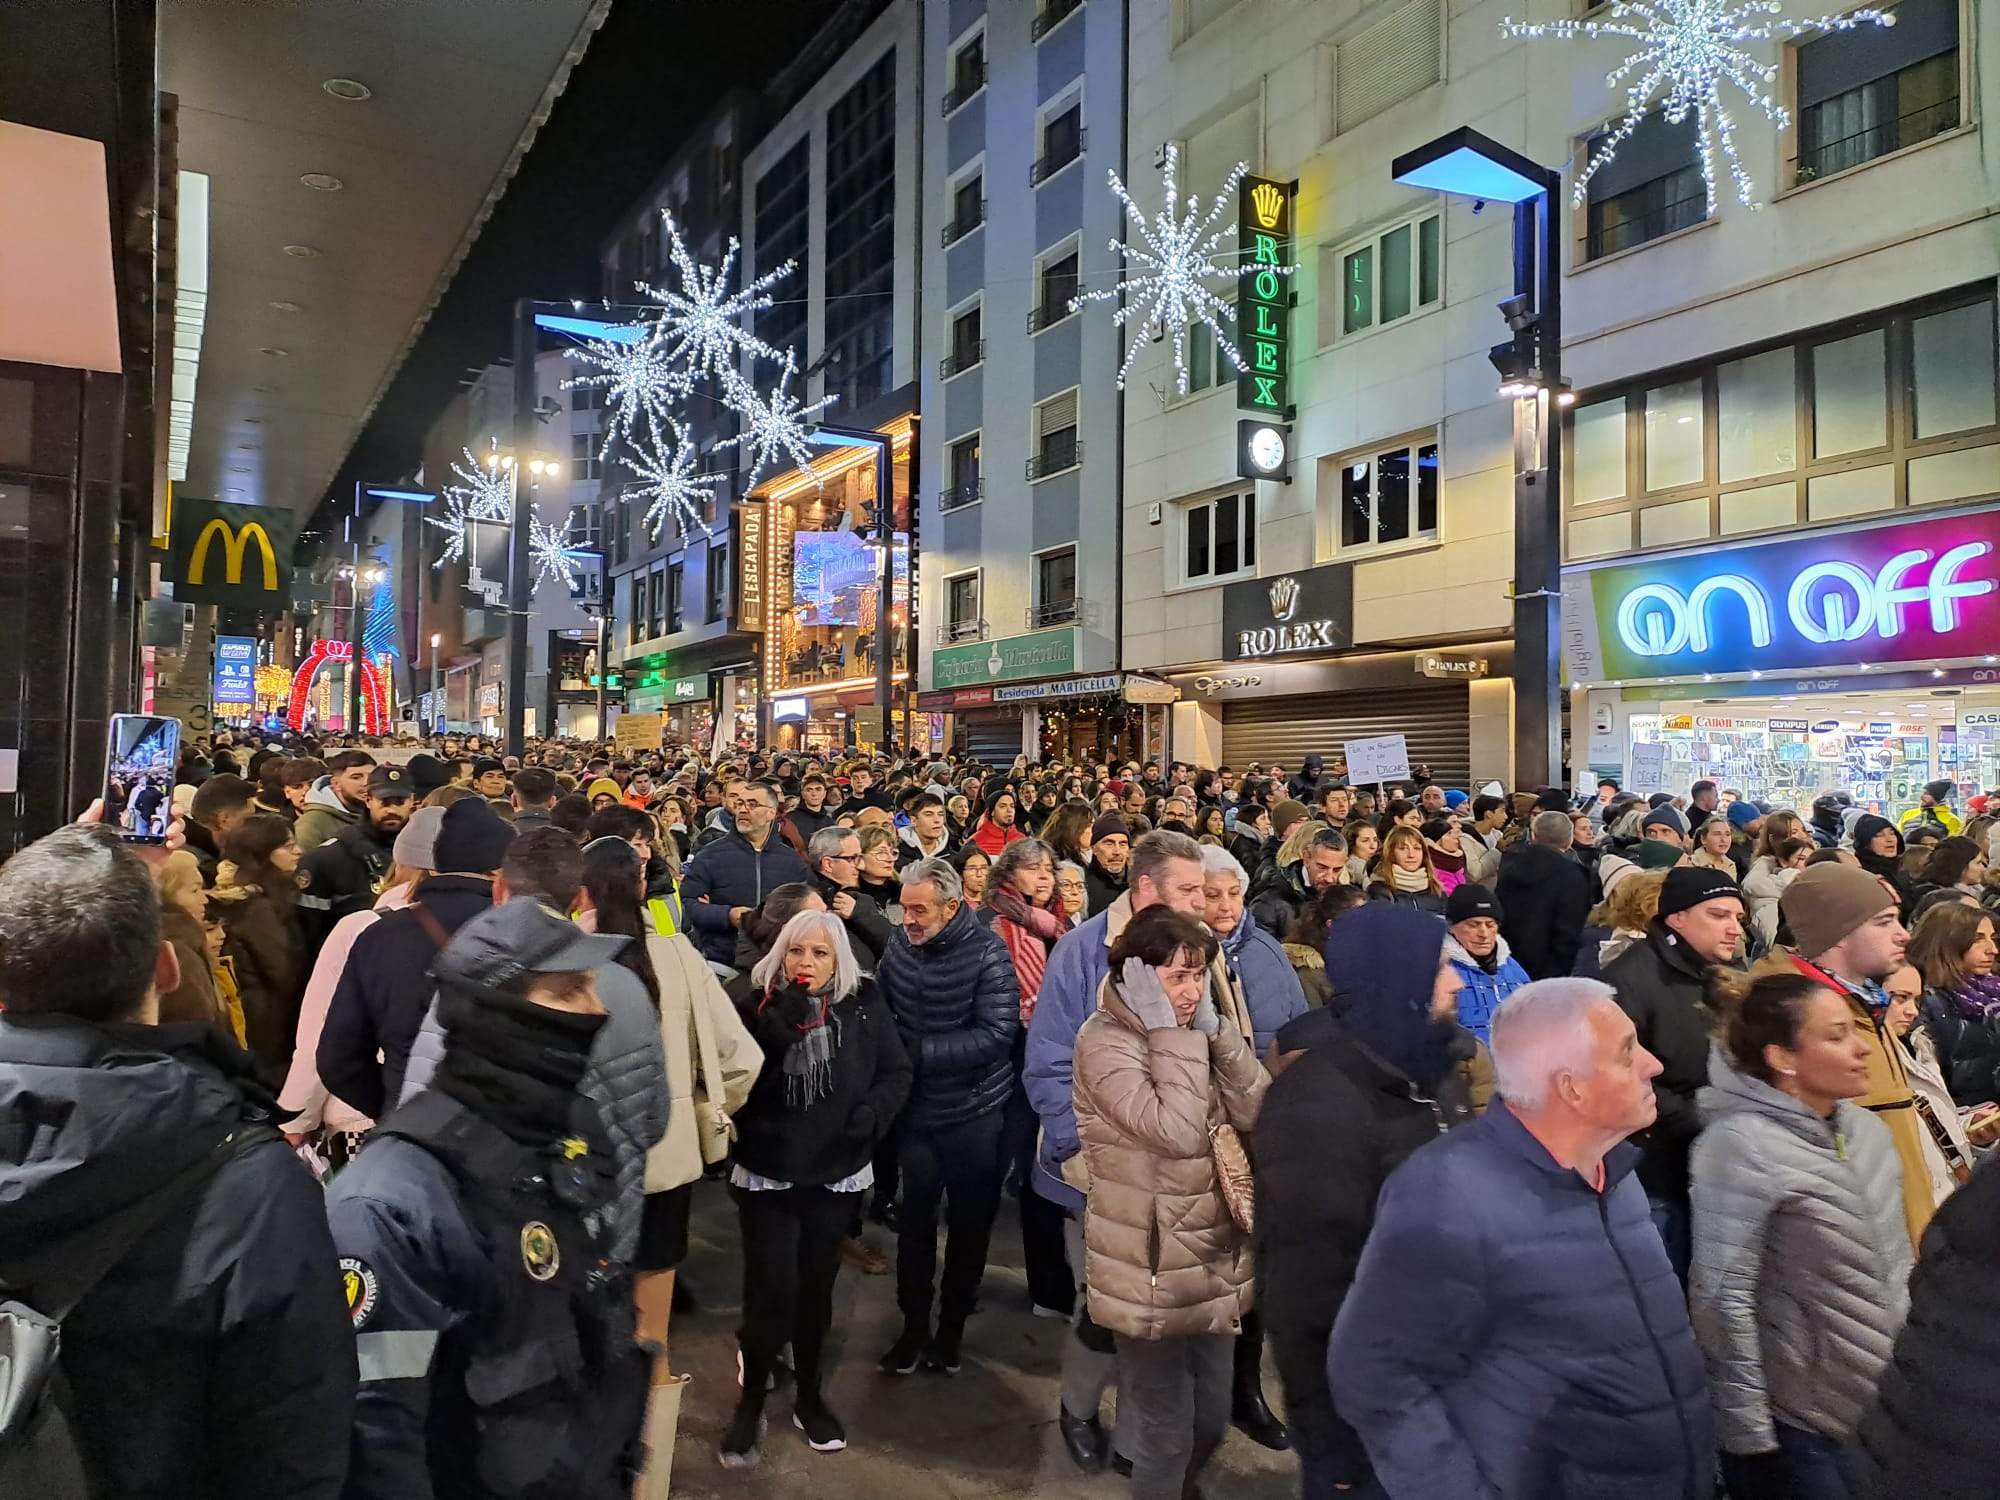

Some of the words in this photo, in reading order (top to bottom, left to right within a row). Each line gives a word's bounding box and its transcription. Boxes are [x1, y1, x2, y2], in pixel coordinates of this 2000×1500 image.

[1254, 233, 1280, 406] ROLEX
[744, 508, 762, 604] L'ESCAPADA
[1238, 620, 1333, 656] ROLEX
[1436, 661, 1468, 672] ROLEX
[997, 686, 1045, 700] Residencia
[1050, 678, 1116, 694] MARTICELLA
[1665, 719, 1690, 729] Nikon
[1696, 717, 1732, 728] Canon
[1964, 714, 2000, 724] CAS
[1769, 721, 1807, 730] OLYMPUS
